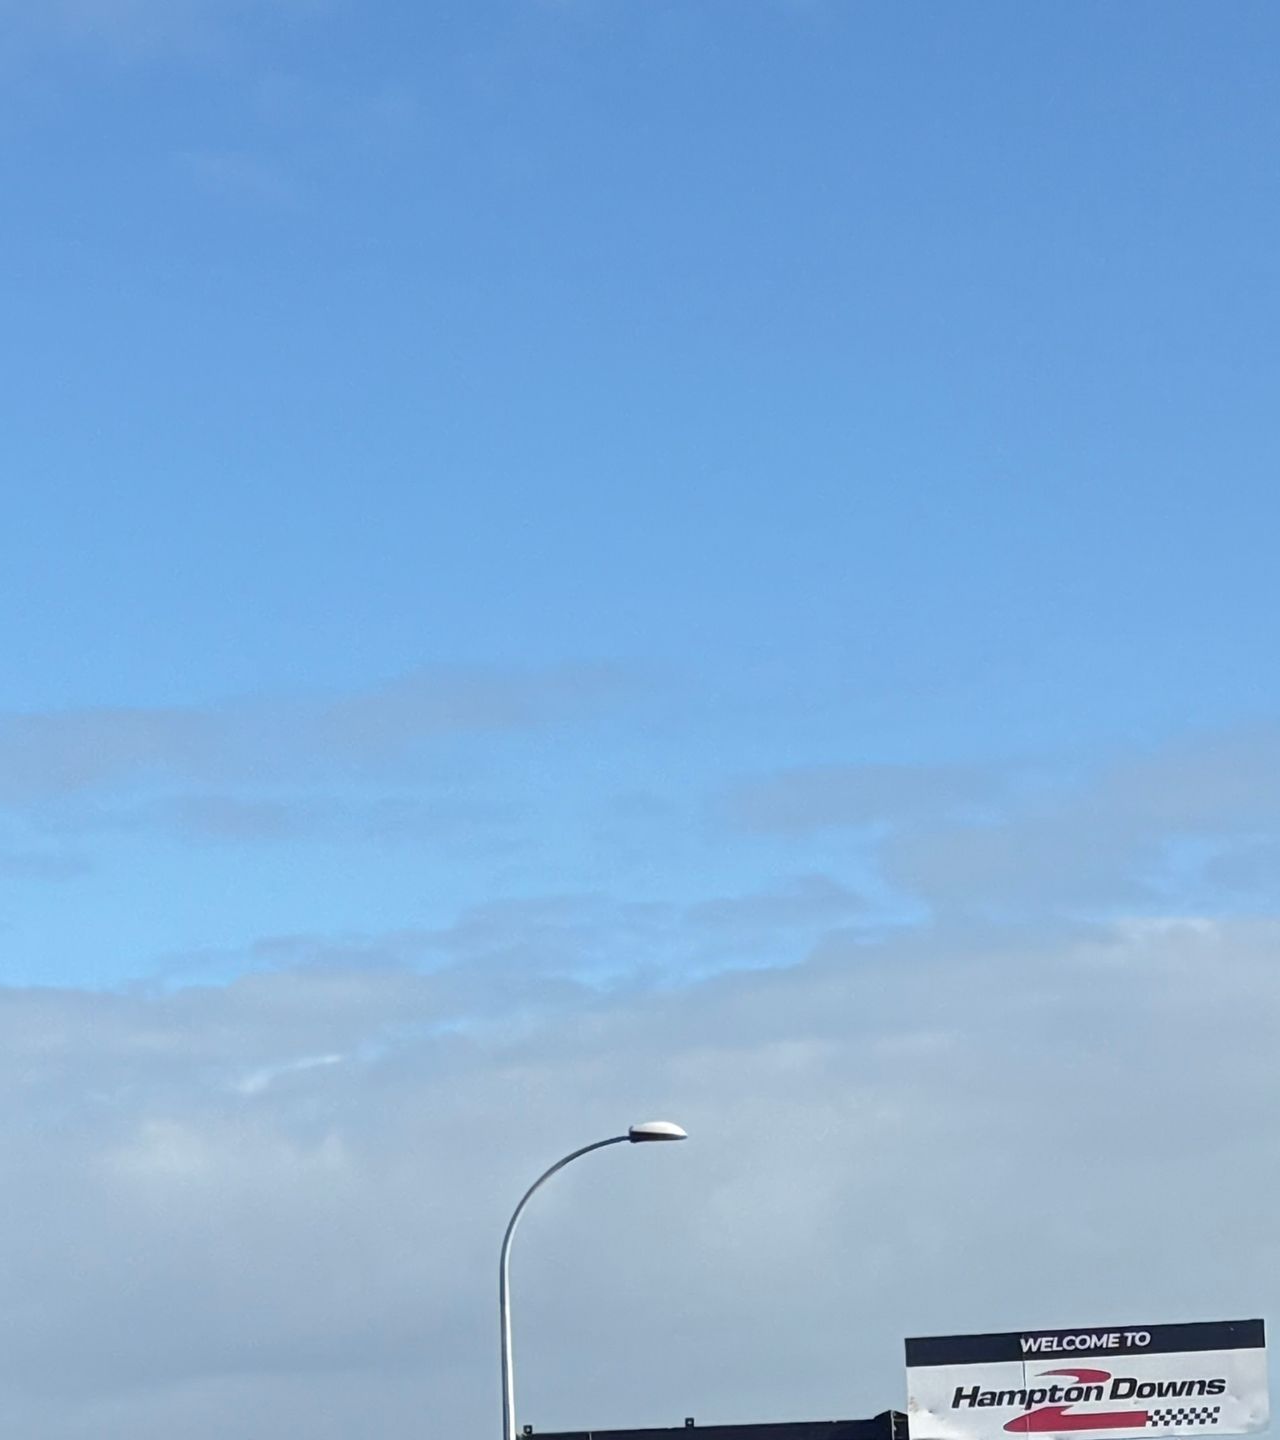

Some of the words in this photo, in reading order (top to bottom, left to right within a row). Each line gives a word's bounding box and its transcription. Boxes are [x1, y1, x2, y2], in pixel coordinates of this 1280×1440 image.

[1020, 1333, 1120, 1353] WELCOME
[1123, 1331, 1151, 1347] TO
[951, 1383, 1104, 1410] Hampton
[1110, 1377, 1226, 1400] Downs
